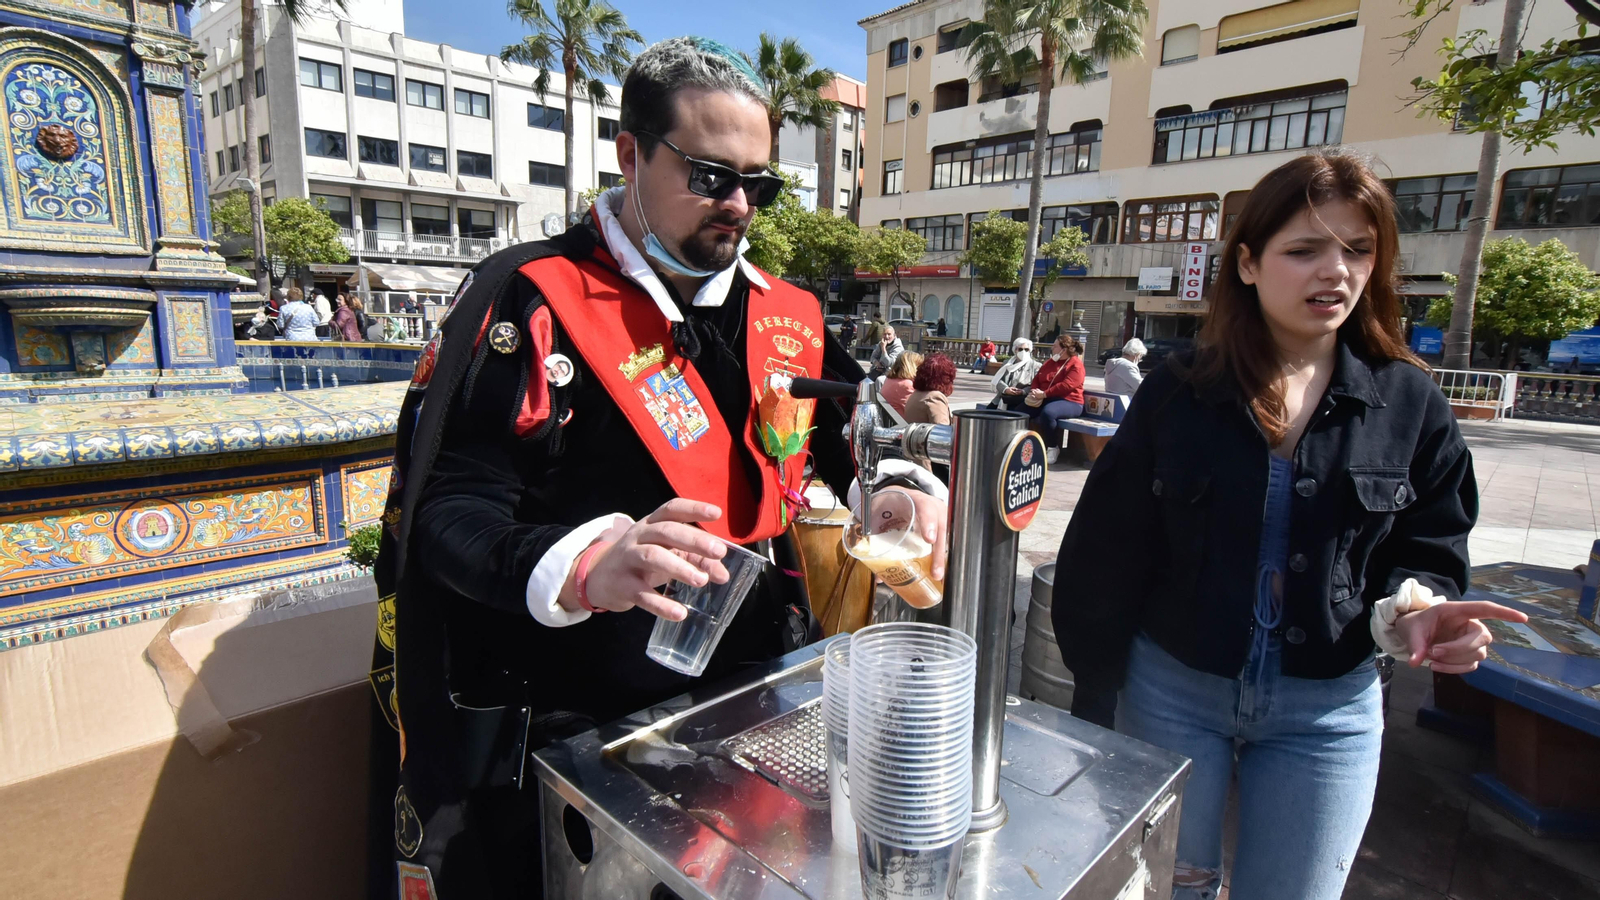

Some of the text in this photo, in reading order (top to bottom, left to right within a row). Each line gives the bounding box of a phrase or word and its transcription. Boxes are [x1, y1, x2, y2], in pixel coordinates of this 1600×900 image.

[1186, 245, 1203, 298] BINGO
[754, 316, 822, 348] DERECHO
[1007, 463, 1042, 490] Estrella
[1008, 482, 1040, 509] Galicia
[377, 674, 390, 683] Ich
